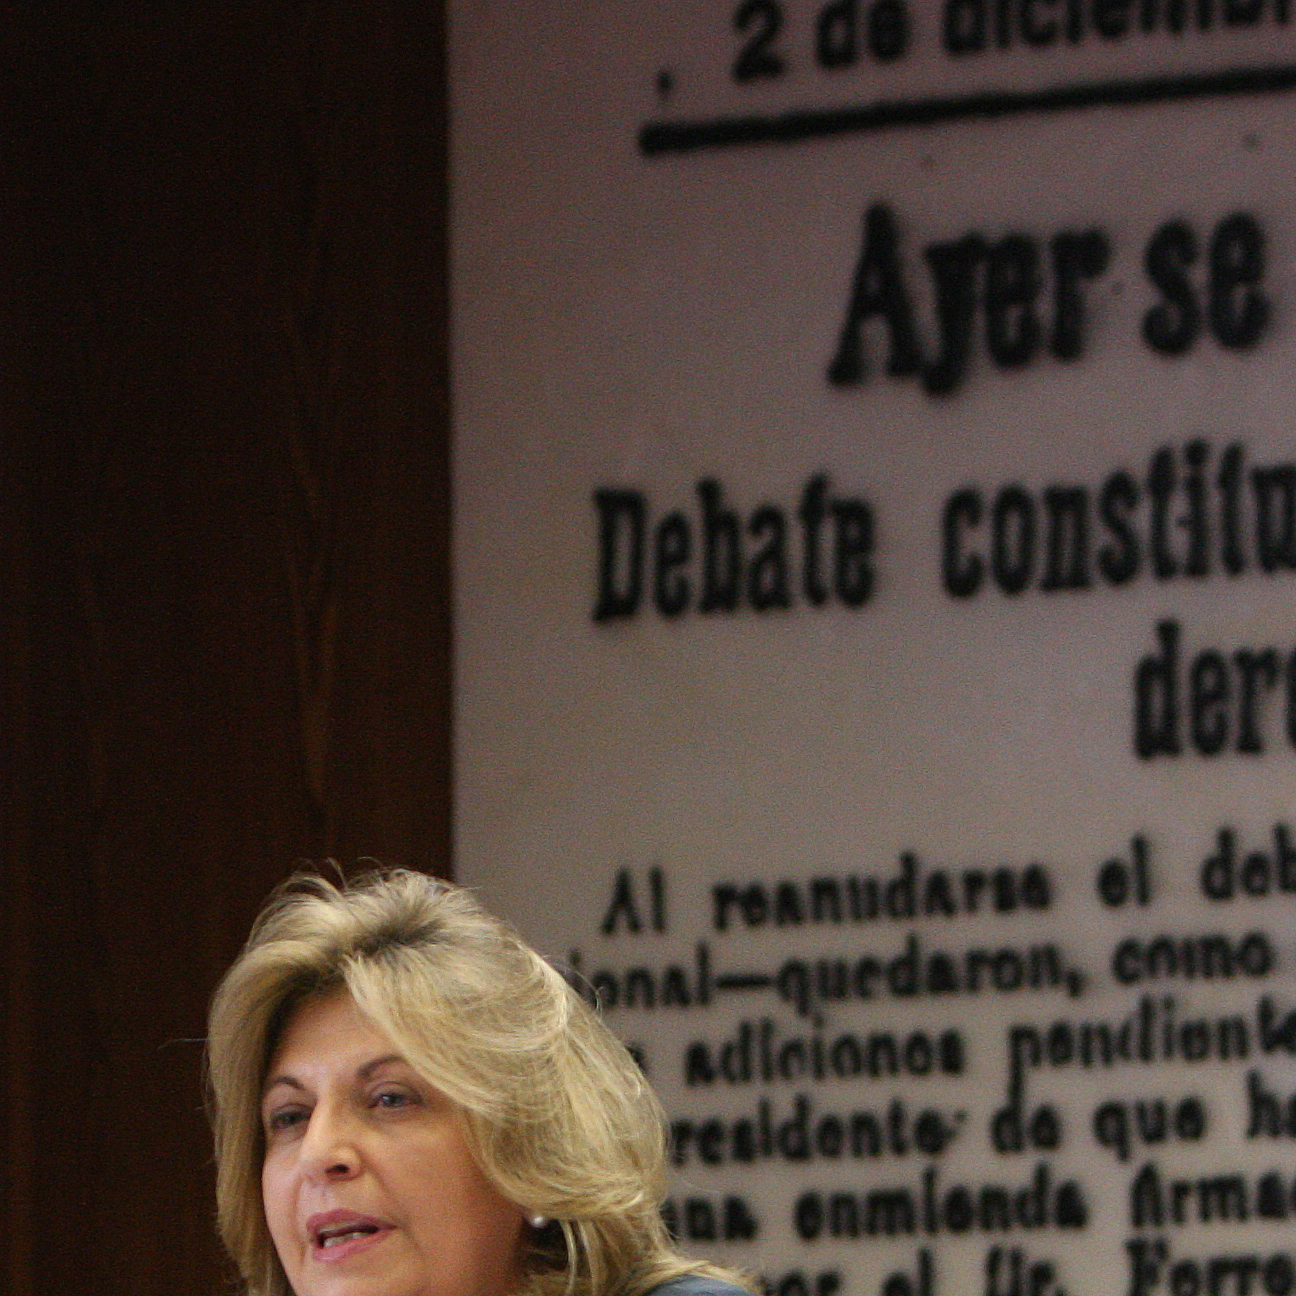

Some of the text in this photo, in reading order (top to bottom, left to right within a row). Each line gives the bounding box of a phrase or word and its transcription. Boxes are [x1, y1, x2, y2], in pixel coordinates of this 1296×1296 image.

[826, 200, 1109, 398] Ayer
[1142, 212, 1271, 355] se
[592, 474, 877, 622] Debate
[602, 868, 667, 935] Al
[712, 852, 1051, 932] reanudarse
[1097, 833, 1149, 908] el
[1112, 930, 1274, 985] como
[684, 1017, 966, 1085] adiciones
[670, 1096, 956, 1168] residente
[991, 1085, 1062, 1158] de
[1092, 1096, 1206, 1162] que
[792, 1165, 1089, 1242] enmienda
